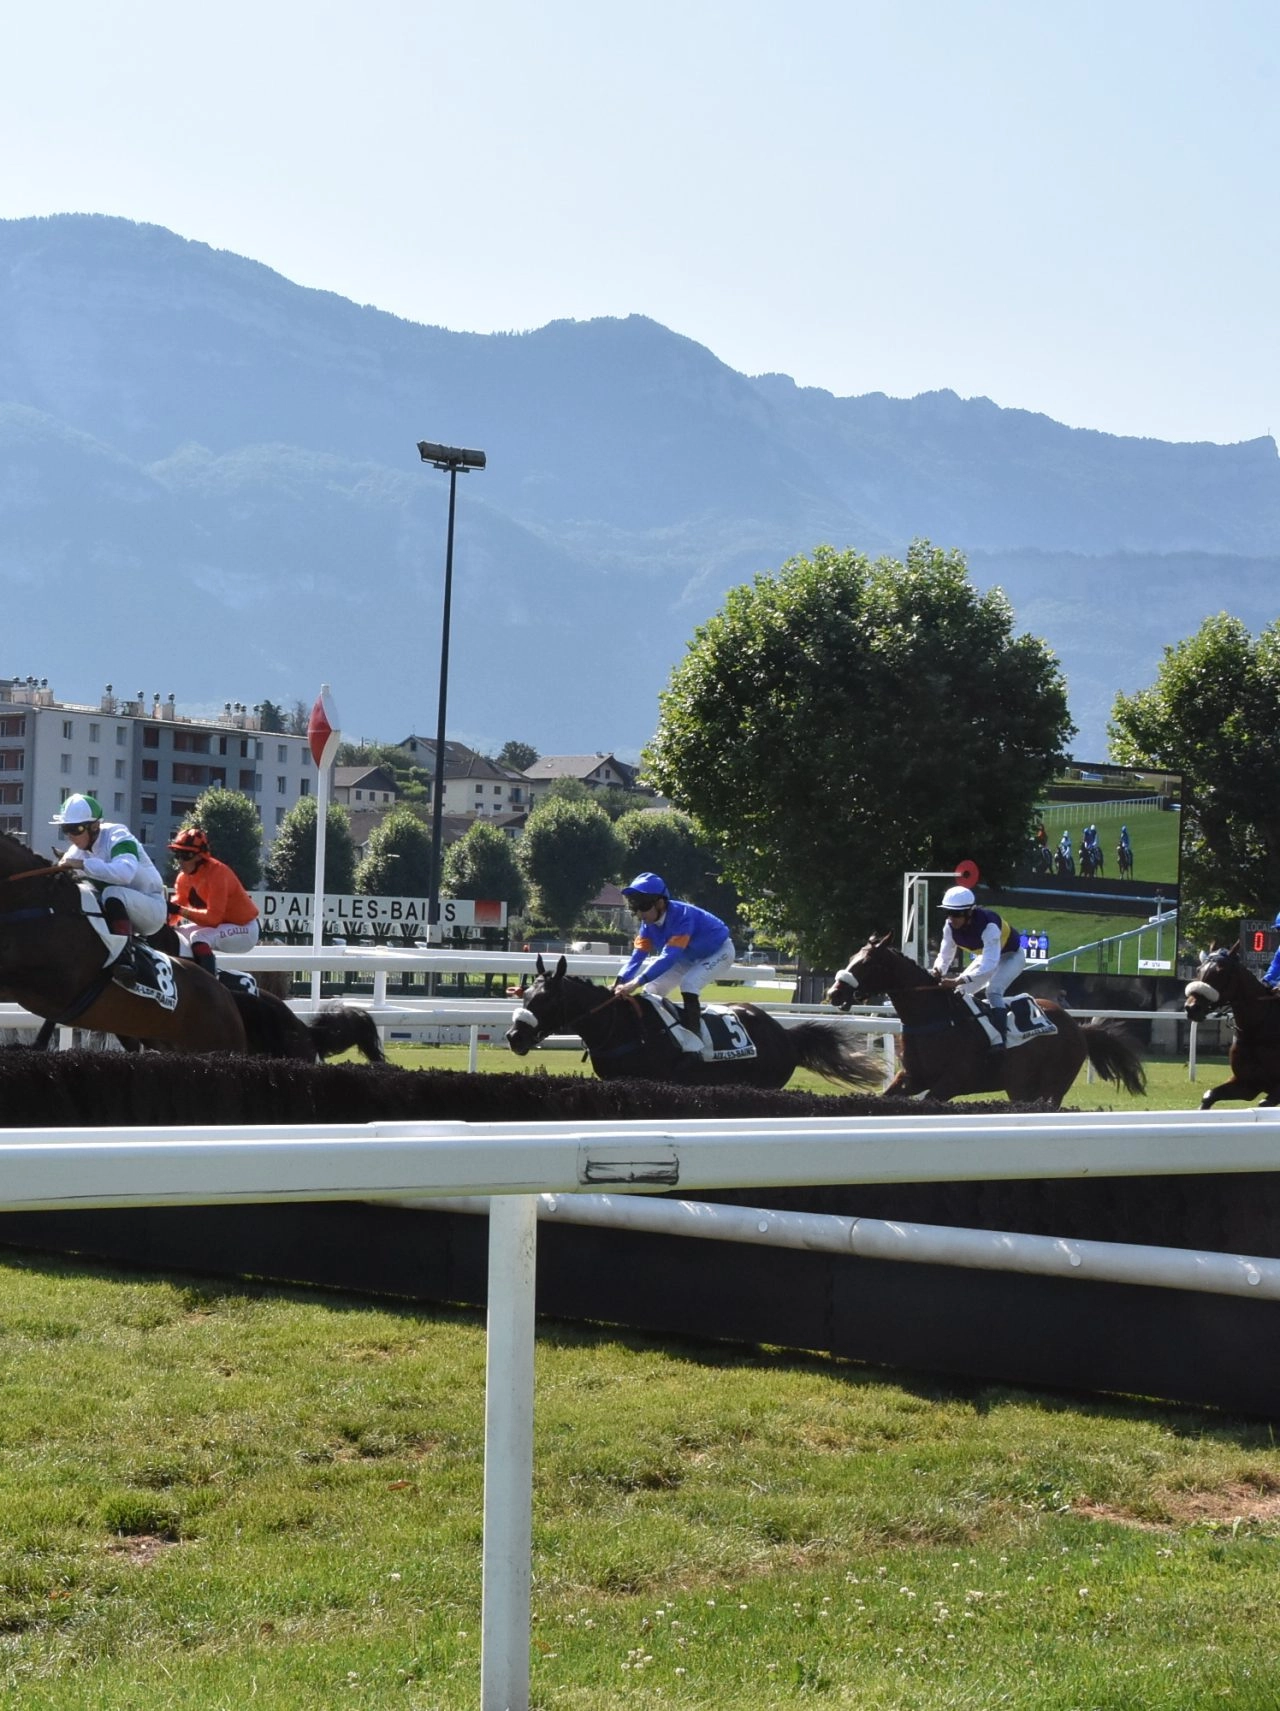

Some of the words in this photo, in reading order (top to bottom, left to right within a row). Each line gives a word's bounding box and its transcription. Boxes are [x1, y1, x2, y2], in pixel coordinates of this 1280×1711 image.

[264, 895, 456, 921] D'AI-LES-BAIS
[333, 923, 339, 933] 6
[363, 924, 368, 933] 5
[446, 926, 452, 936] 2
[155, 962, 174, 996] 8
[1027, 999, 1052, 1027] 4
[722, 1014, 748, 1048] 5
